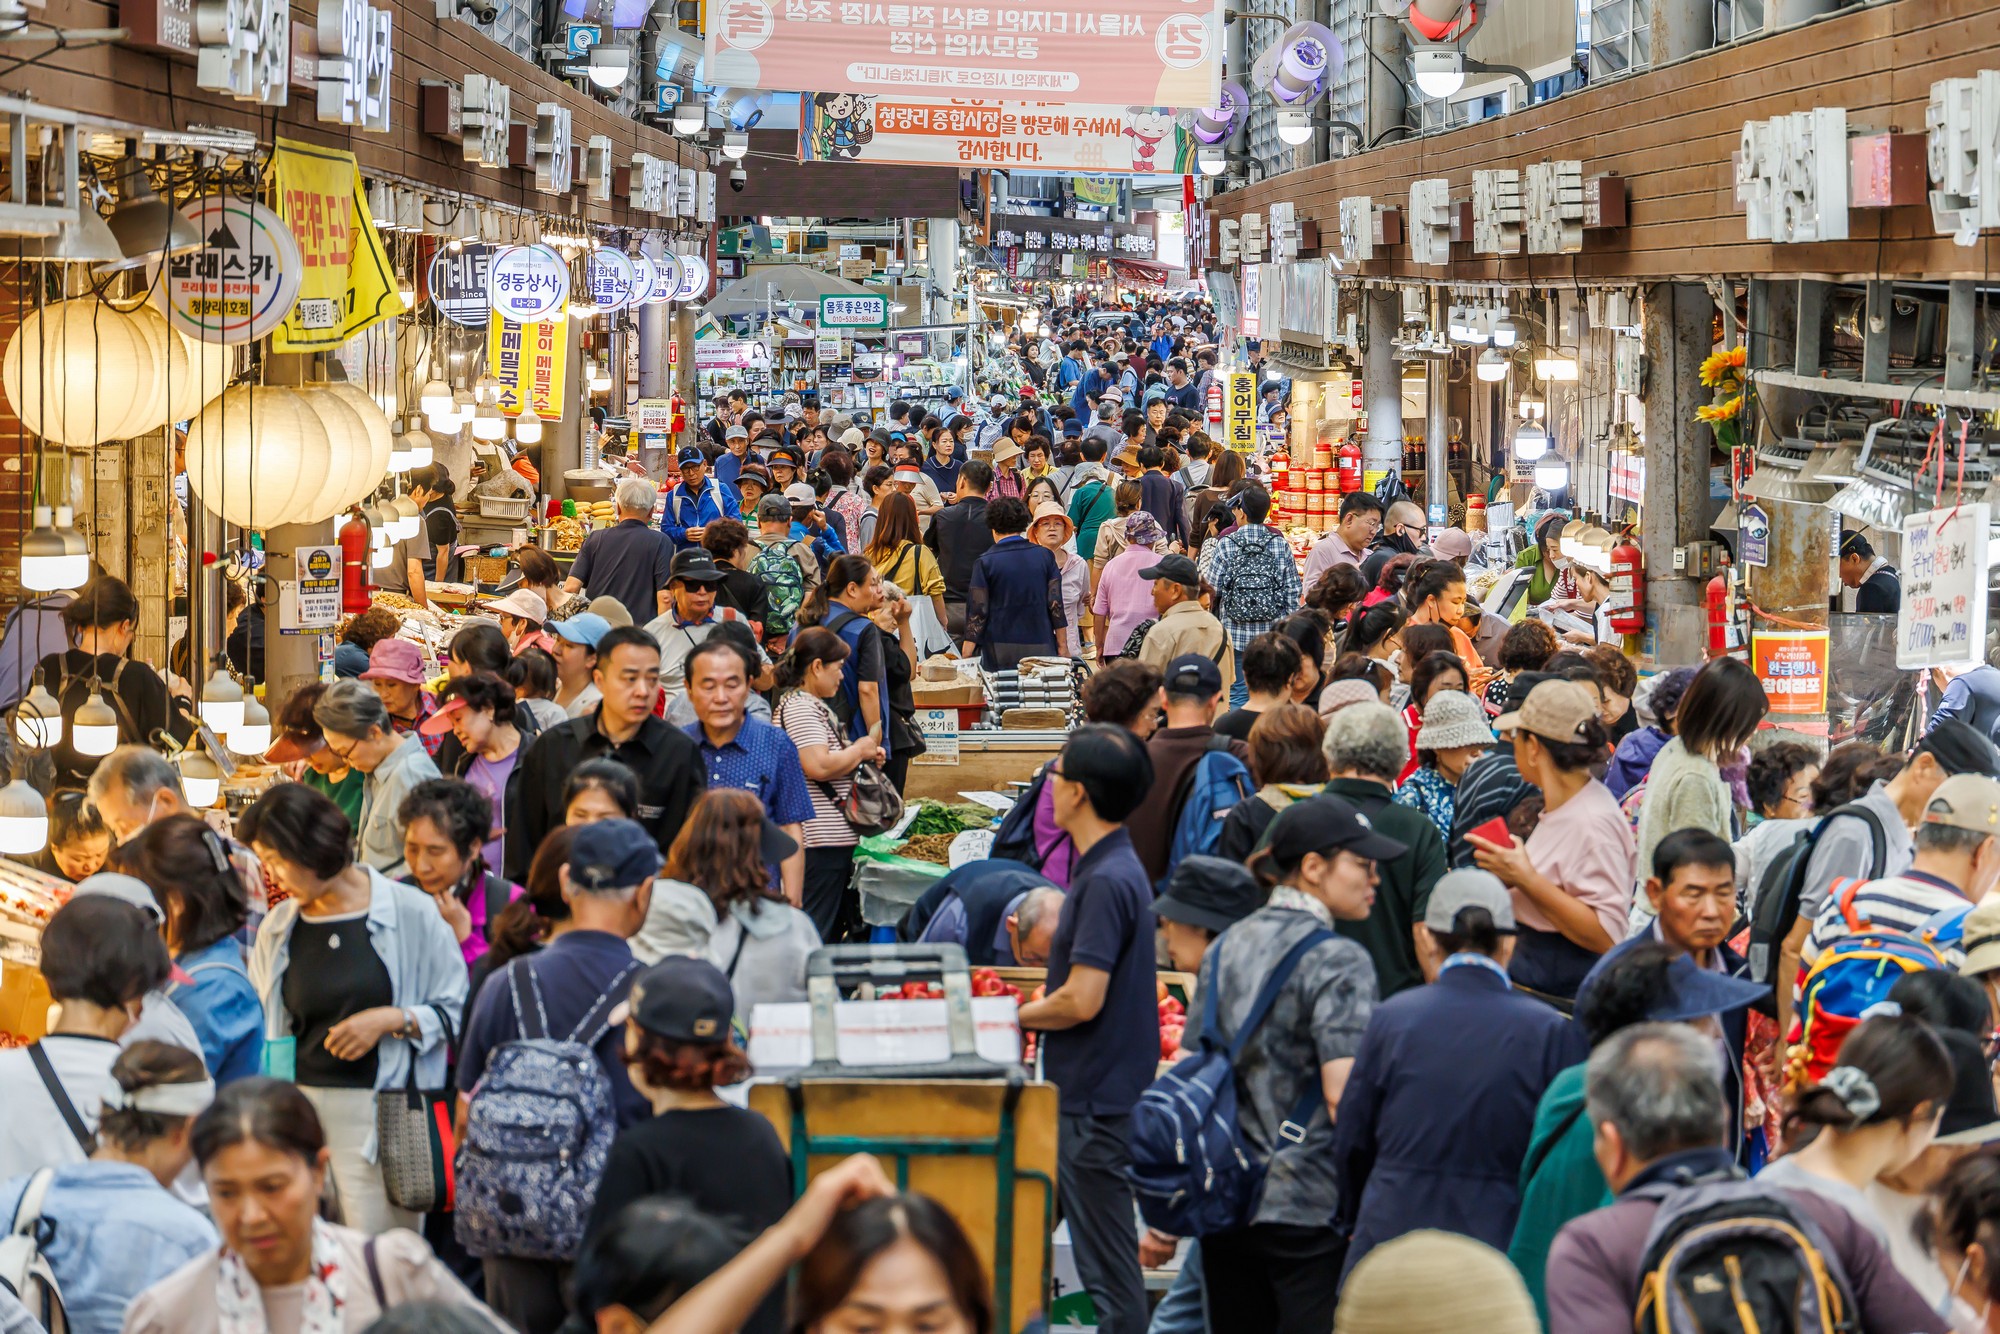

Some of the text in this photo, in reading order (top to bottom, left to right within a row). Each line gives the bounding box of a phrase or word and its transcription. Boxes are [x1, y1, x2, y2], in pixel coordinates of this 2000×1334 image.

[880, 107, 1120, 137] 청량리 종합시장을 방문해 주셔서
[957, 140, 1042, 162] 감사합니다.
[171, 252, 273, 281] 알래스카
[496, 272, 557, 294] 경동상사
[460, 291, 484, 299] Since
[516, 299, 537, 309] 나-28
[833, 315, 875, 323] 010-5336-8944
[534, 320, 555, 410] 말이 메밀국수
[1233, 377, 1253, 441] 홍어무침
[1768, 660, 1816, 676] 환급행사
[1762, 677, 1820, 694] 참여점포
